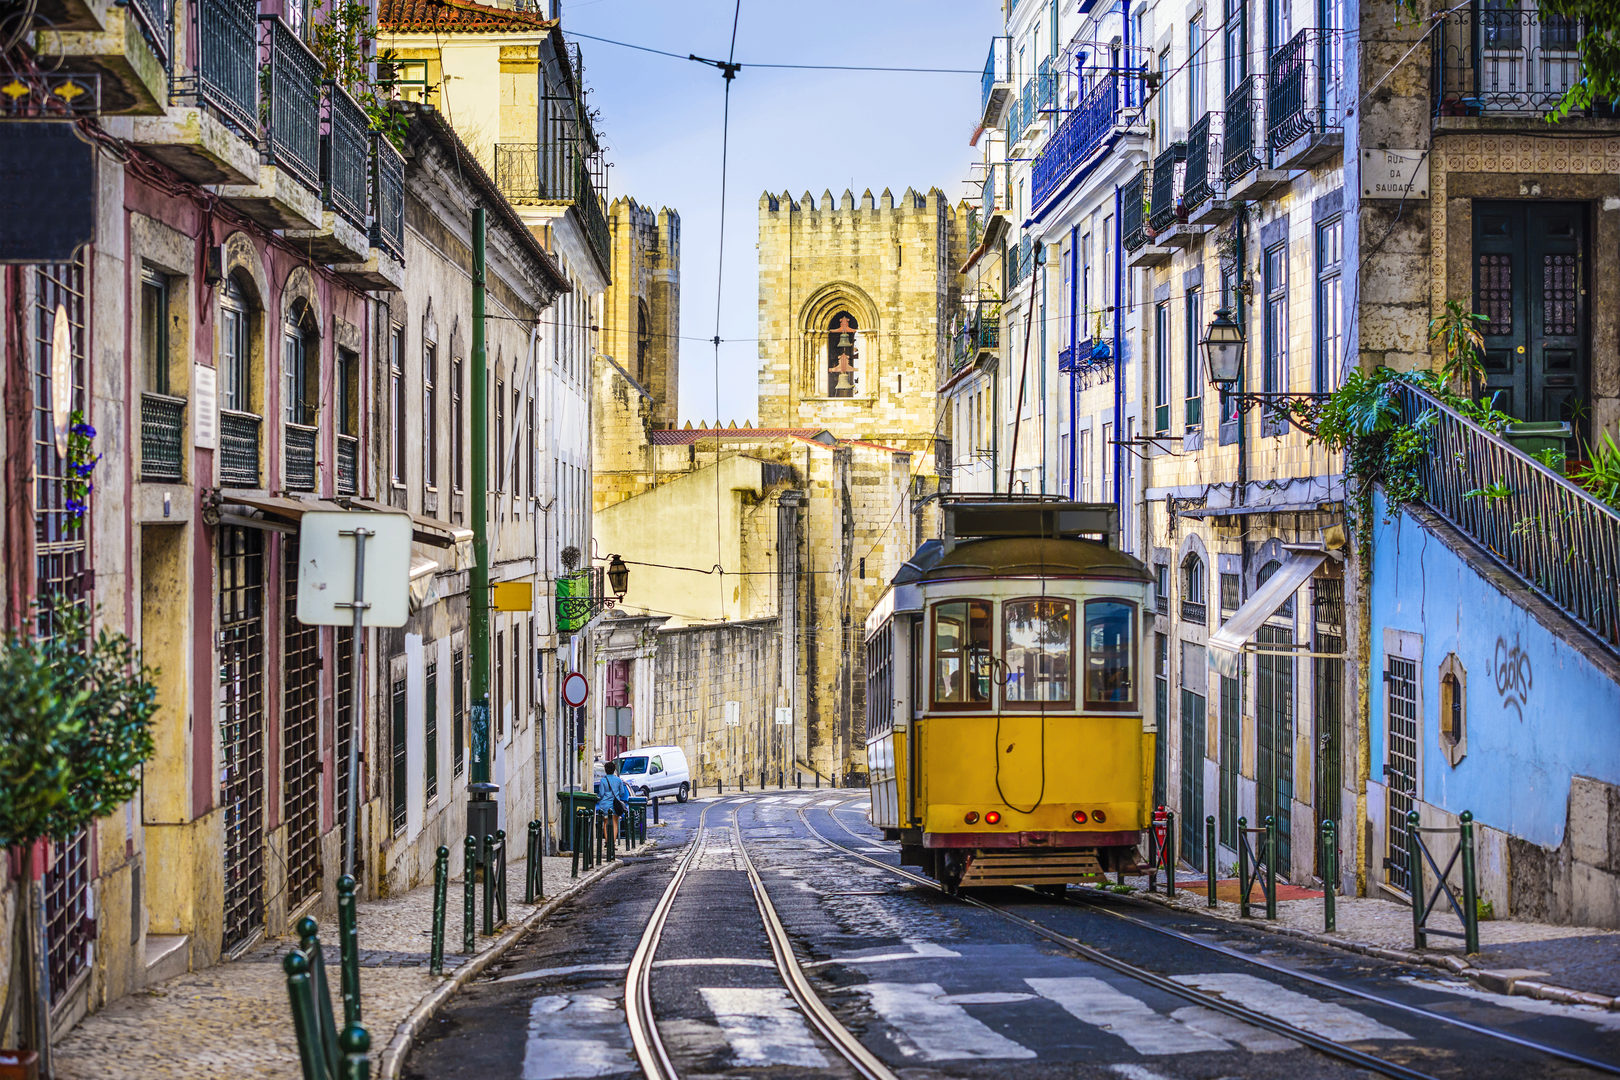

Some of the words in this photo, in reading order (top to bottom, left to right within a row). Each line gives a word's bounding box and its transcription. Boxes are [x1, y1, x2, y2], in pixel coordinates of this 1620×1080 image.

[1387, 156, 1404, 164] RUA
[1390, 170, 1401, 178] DA
[1376, 184, 1415, 192] SAUDADE
